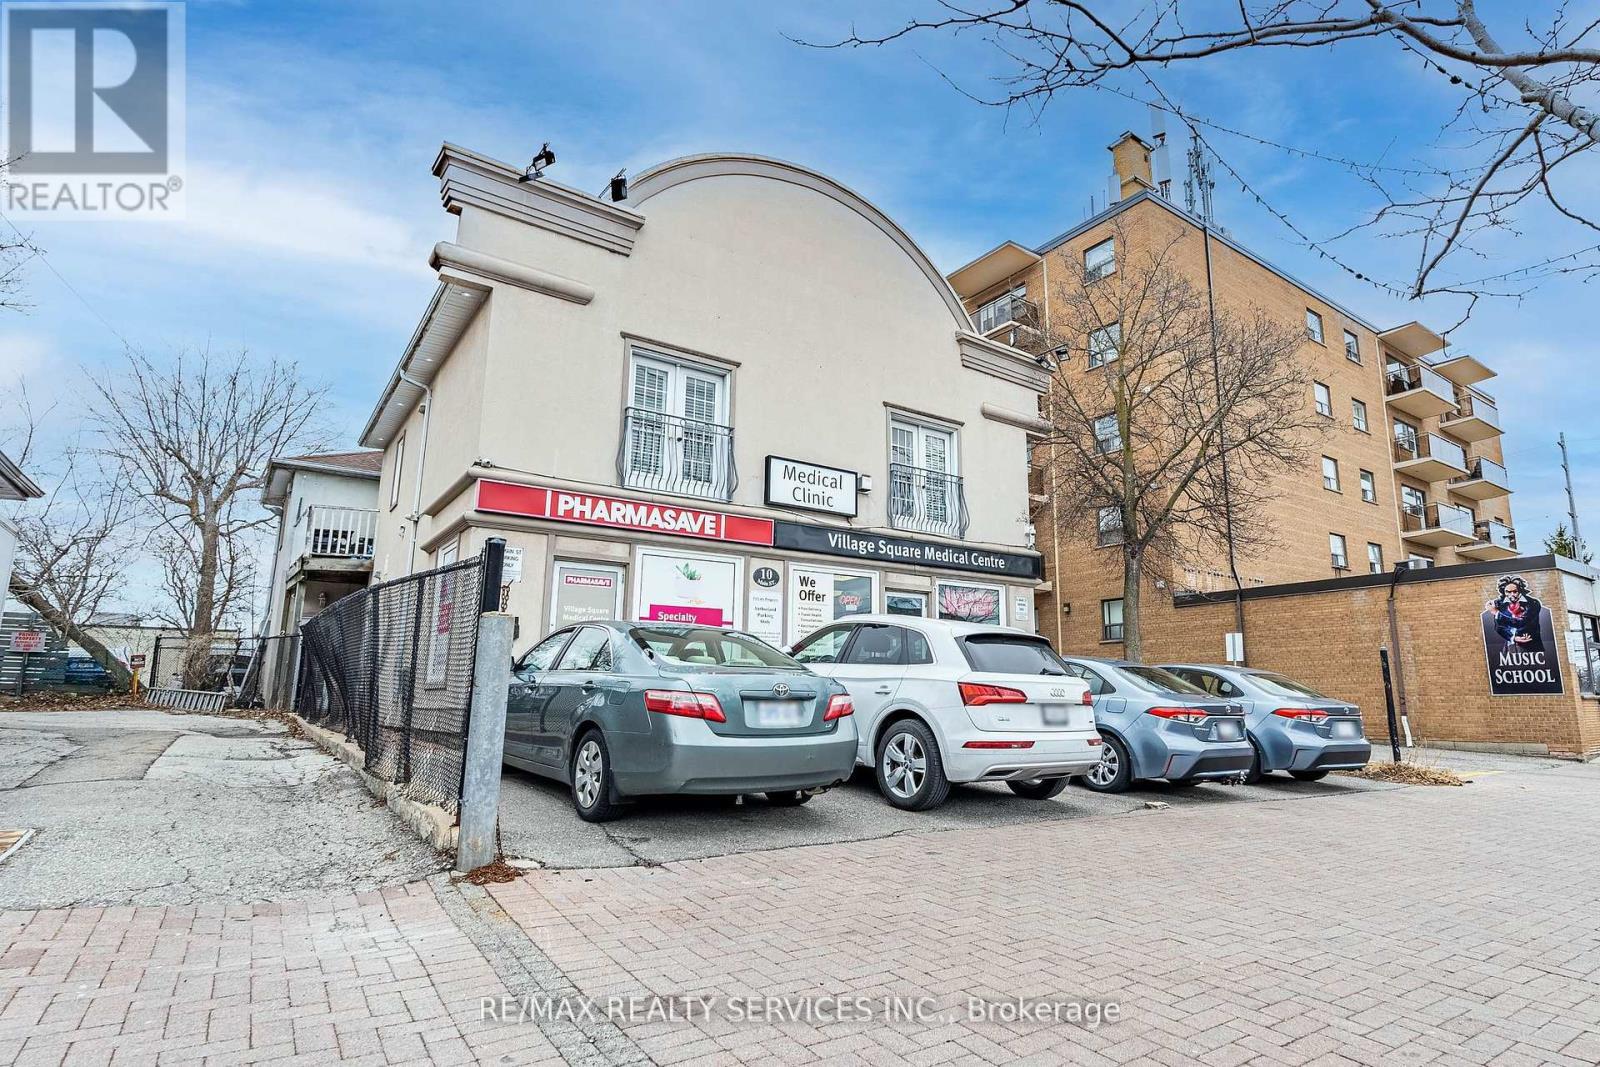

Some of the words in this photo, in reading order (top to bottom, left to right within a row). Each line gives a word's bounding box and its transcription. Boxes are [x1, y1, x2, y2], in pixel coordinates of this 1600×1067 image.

[783, 464, 844, 490] Medical
[792, 486, 835, 508] Clinic
[557, 495, 716, 536] PHARMASAVE
[828, 533, 876, 555] Village
[878, 540, 922, 560] Square
[924, 547, 969, 565] Medical
[971, 553, 1006, 569] Centre
[761, 568, 773, 580] 10
[566, 576, 611, 587] PHARMASAVE
[798, 575, 816, 588] We
[798, 589, 826, 602] Offer
[657, 611, 697, 624] Specialty
